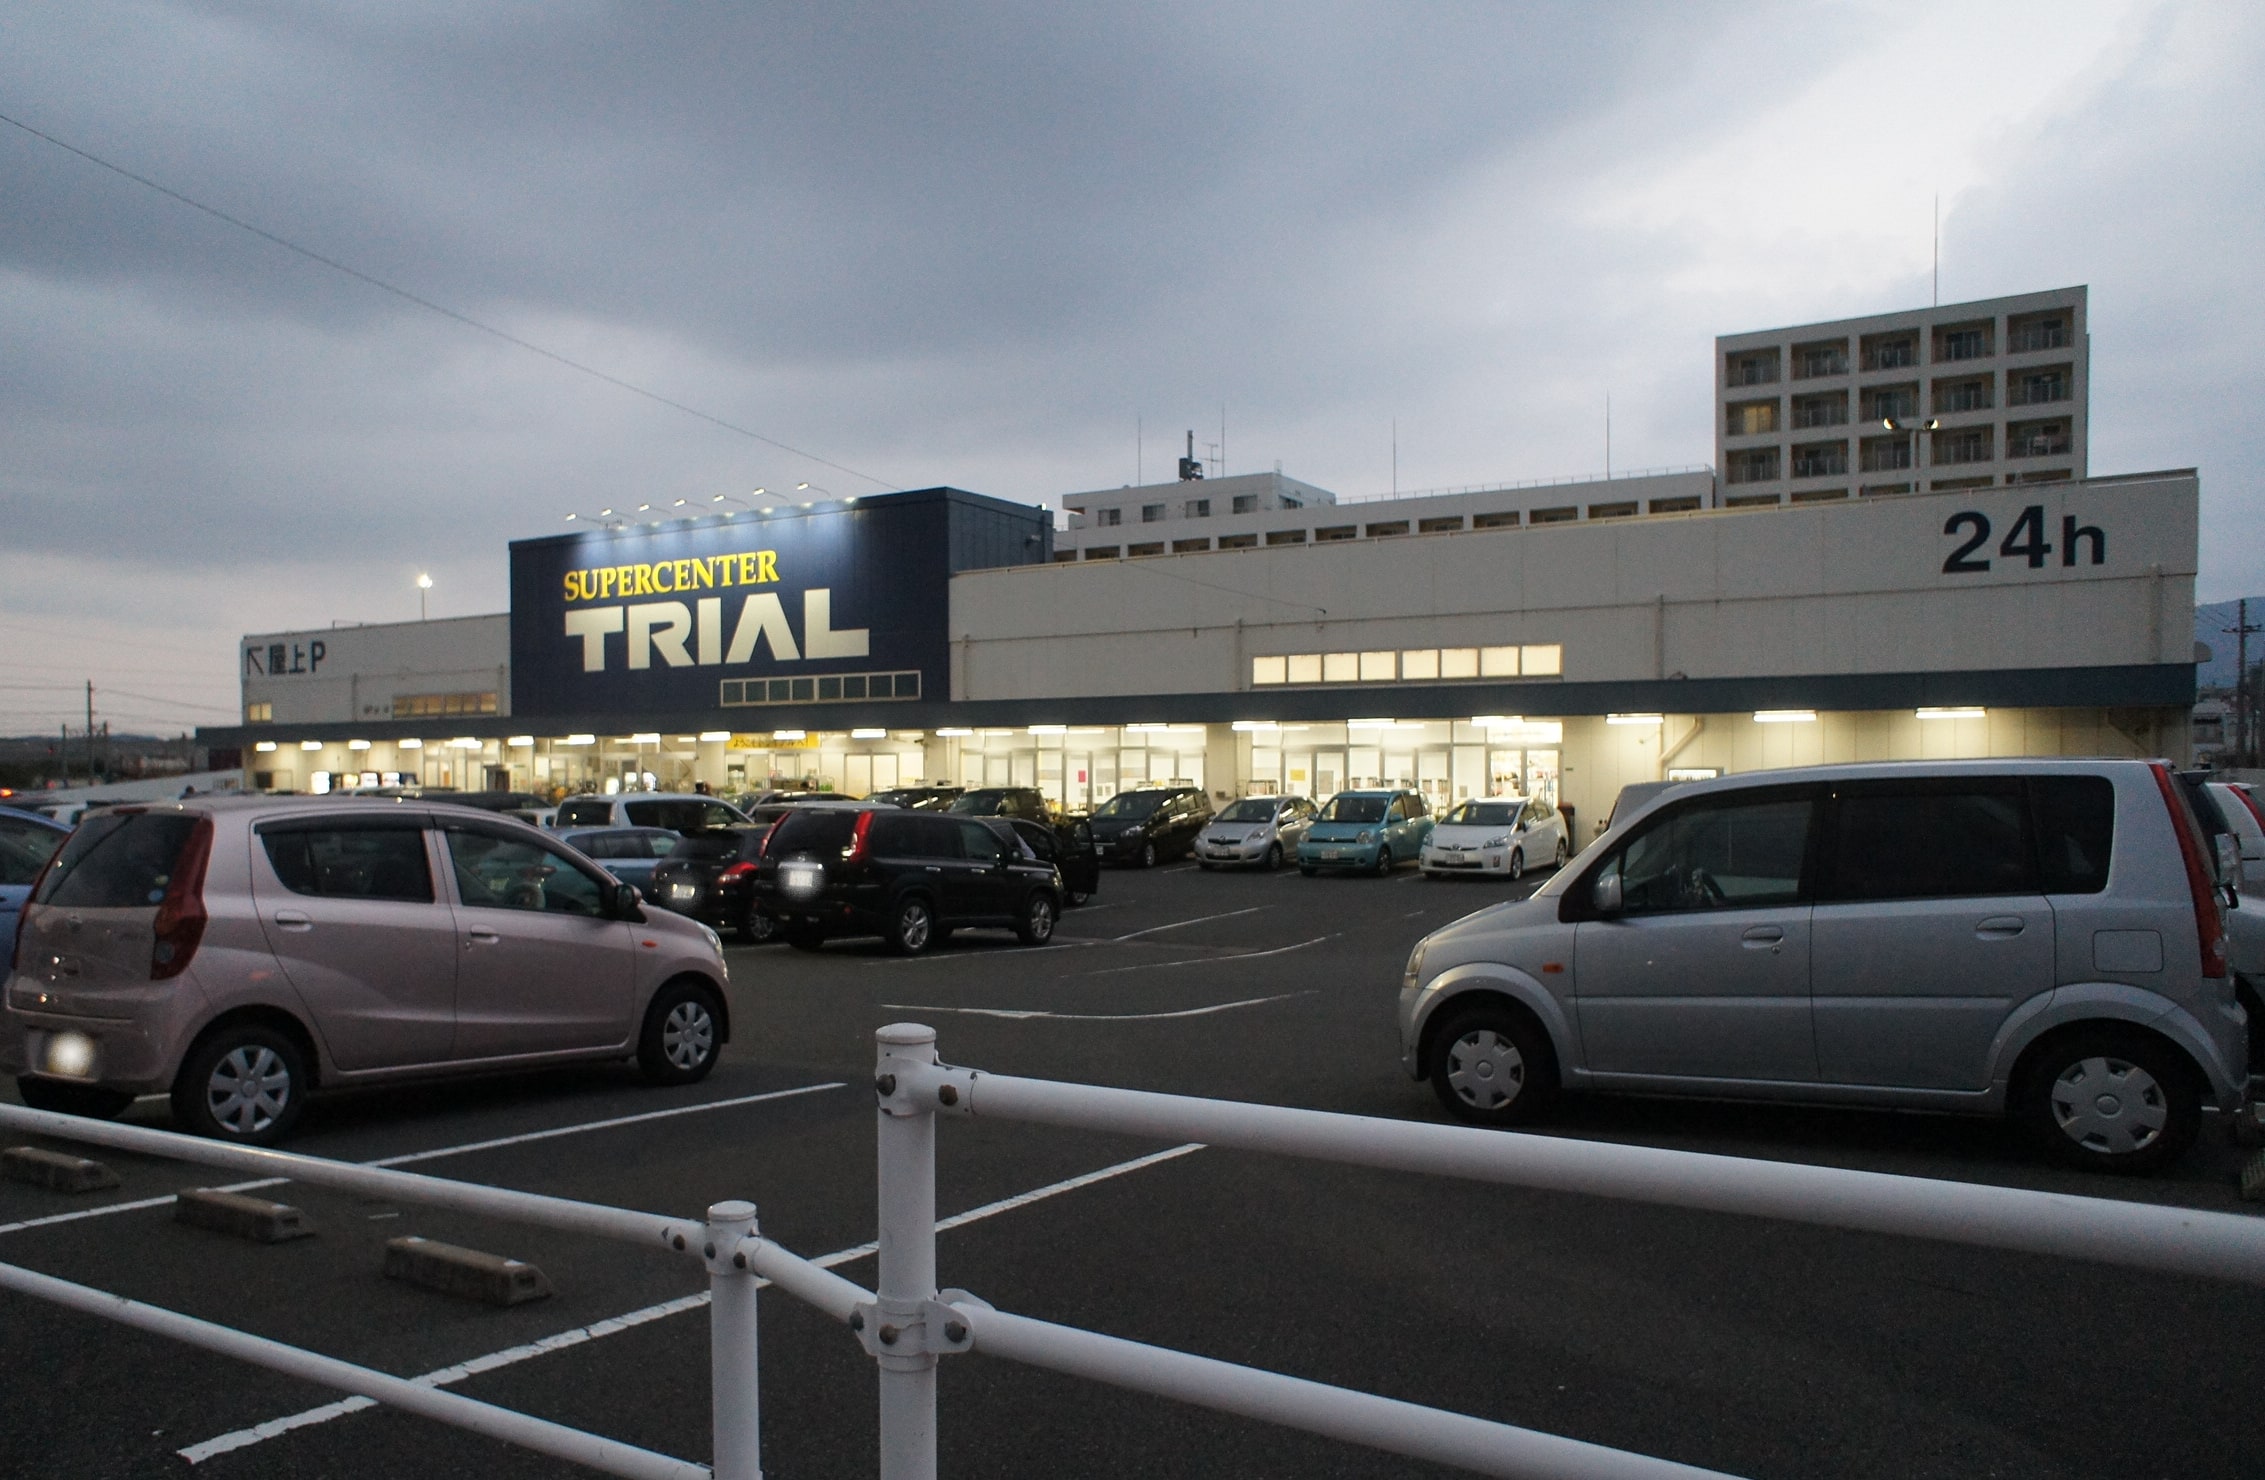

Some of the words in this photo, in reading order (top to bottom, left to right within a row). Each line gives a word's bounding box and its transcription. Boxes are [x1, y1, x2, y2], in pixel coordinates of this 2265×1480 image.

[1942, 505, 2105, 574] 24h
[564, 550, 780, 601] SUPERCENTER
[565, 588, 870, 673] TRIAL
